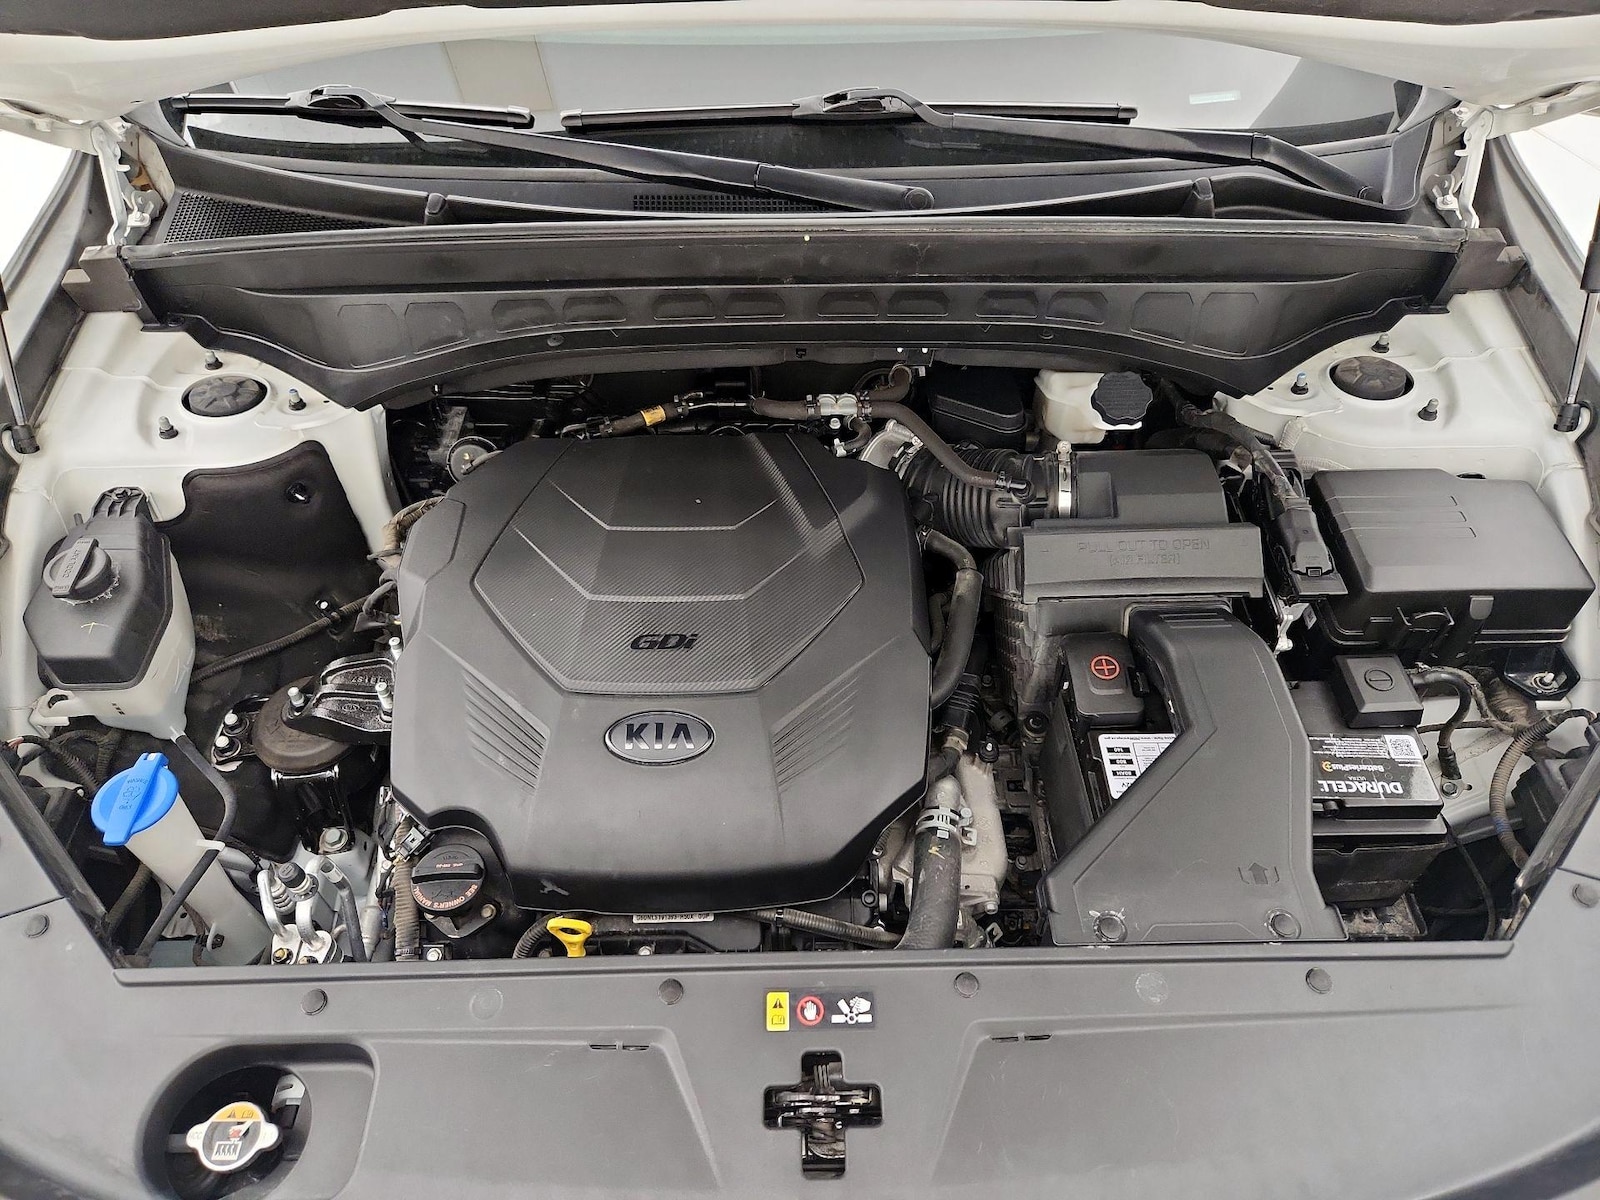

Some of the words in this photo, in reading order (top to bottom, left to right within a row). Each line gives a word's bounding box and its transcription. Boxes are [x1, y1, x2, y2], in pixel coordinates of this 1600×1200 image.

[1078, 541, 1114, 554] PULL
[1118, 540, 1145, 552] OUT
[1149, 540, 1168, 551] TO
[1172, 538, 1210, 551] OPEN
[62, 549, 81, 578] COOLANT
[630, 633, 699, 650] GDi
[624, 722, 695, 750] KIA
[1317, 780, 1404, 794] DURACELL
[413, 886, 433, 907] MANUAL
[465, 884, 478, 898] SEE
[432, 895, 465, 909] OWNER'S
